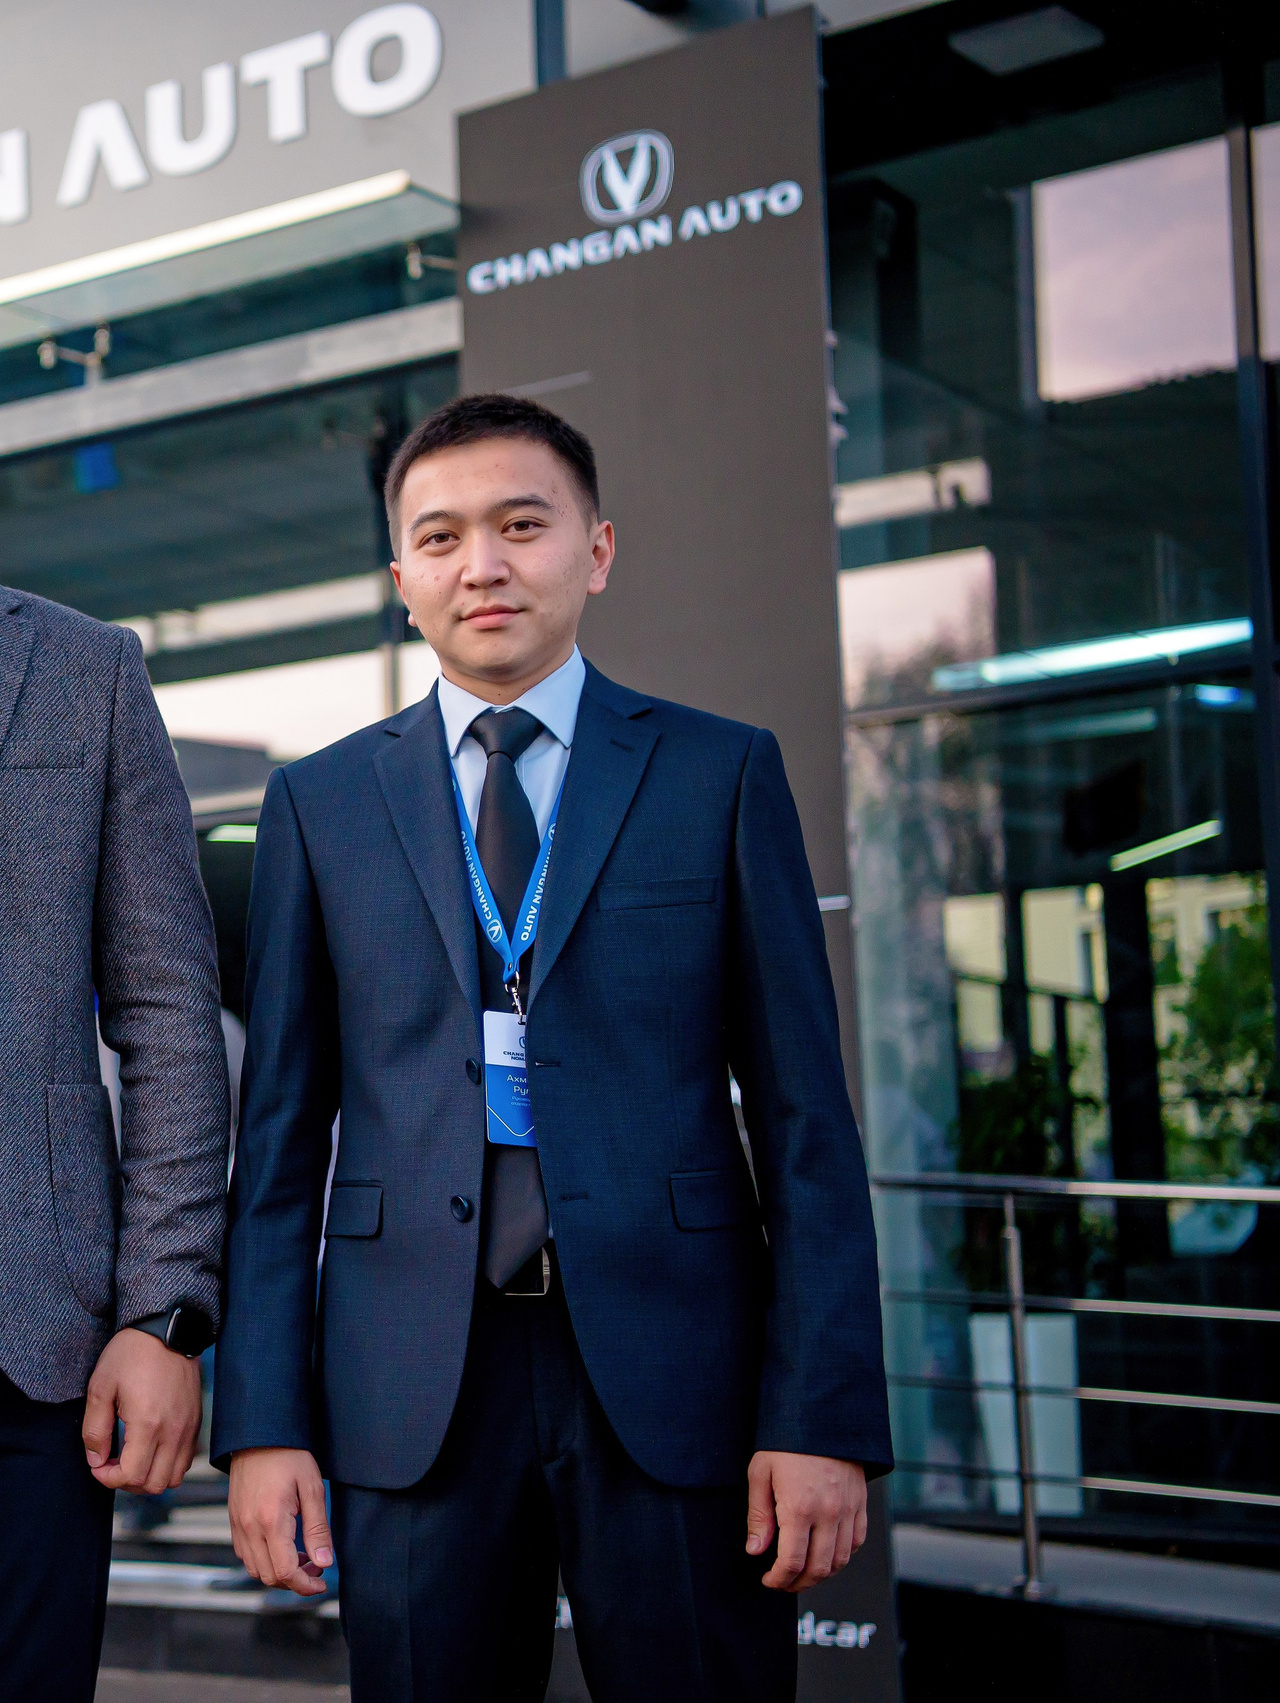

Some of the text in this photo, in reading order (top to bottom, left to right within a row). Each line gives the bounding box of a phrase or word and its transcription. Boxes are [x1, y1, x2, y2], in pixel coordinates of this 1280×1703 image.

[57, 2, 443, 207] AUTO
[466, 180, 803, 294] CHANGAN AUTO
[467, 862, 492, 920] CHANGAN
[520, 905, 538, 941] AUTO
